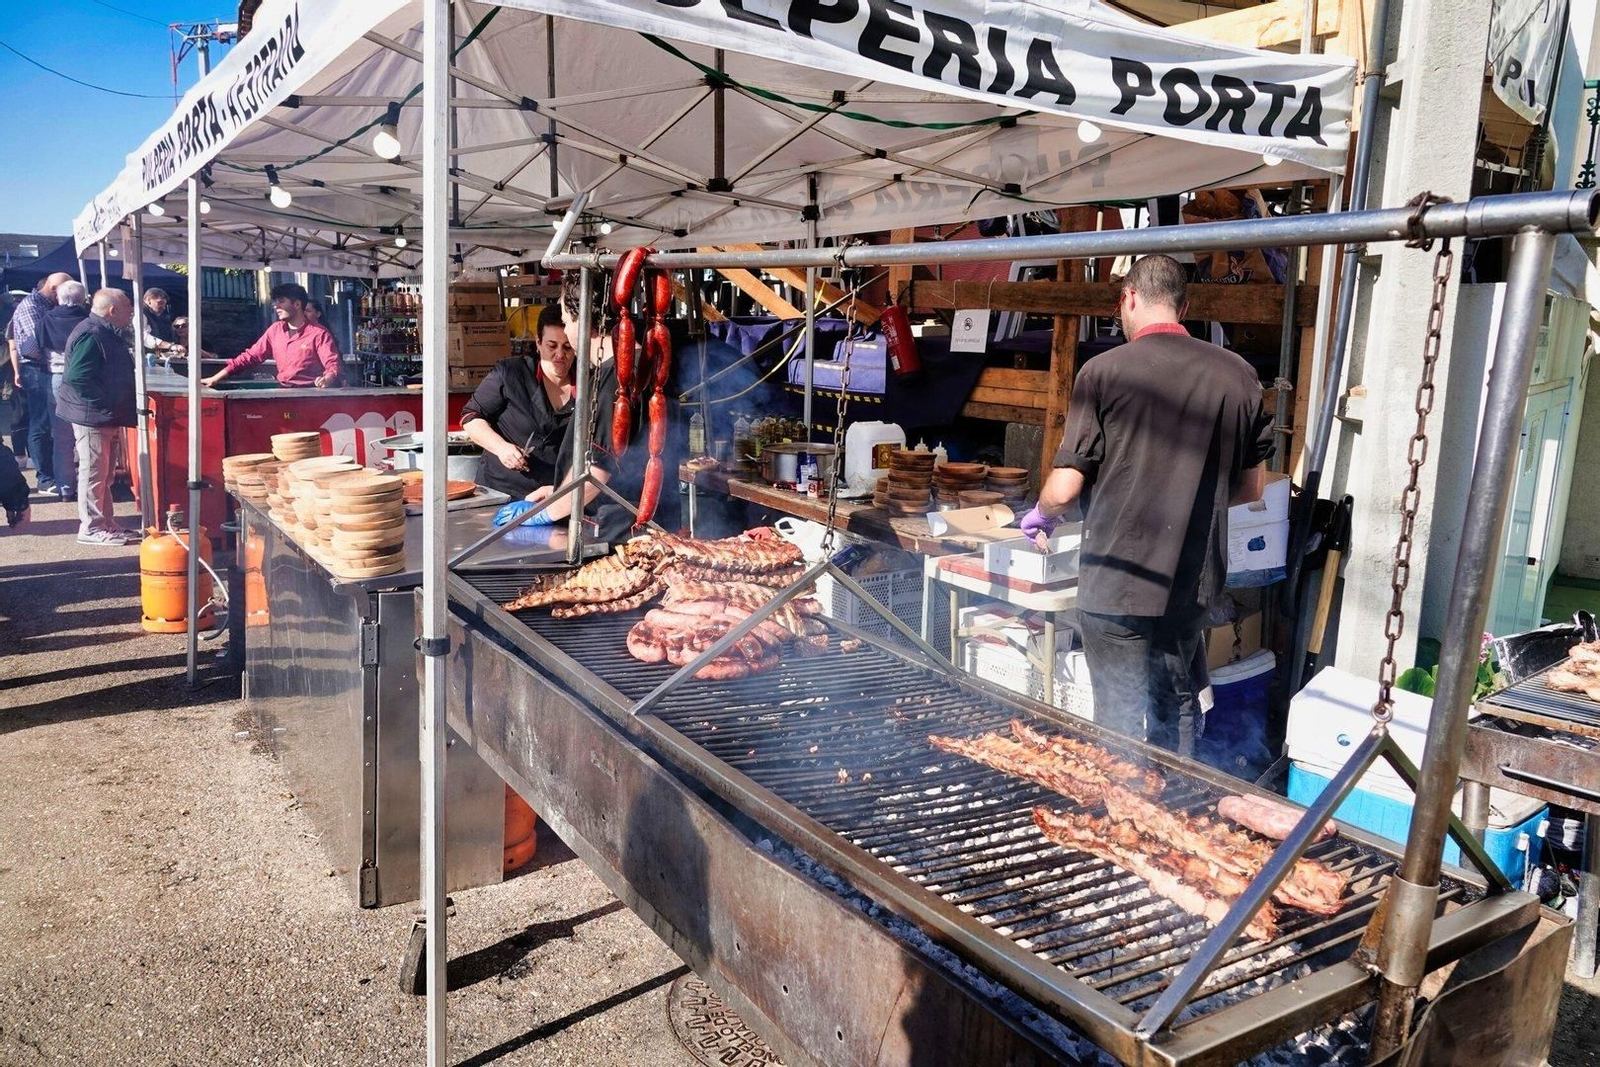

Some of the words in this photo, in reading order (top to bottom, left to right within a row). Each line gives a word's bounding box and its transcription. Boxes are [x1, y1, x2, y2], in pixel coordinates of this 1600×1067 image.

[177, 91, 225, 168] PORTA
[1110, 56, 1328, 147] PORTA
[712, 1011, 728, 1026] DE
